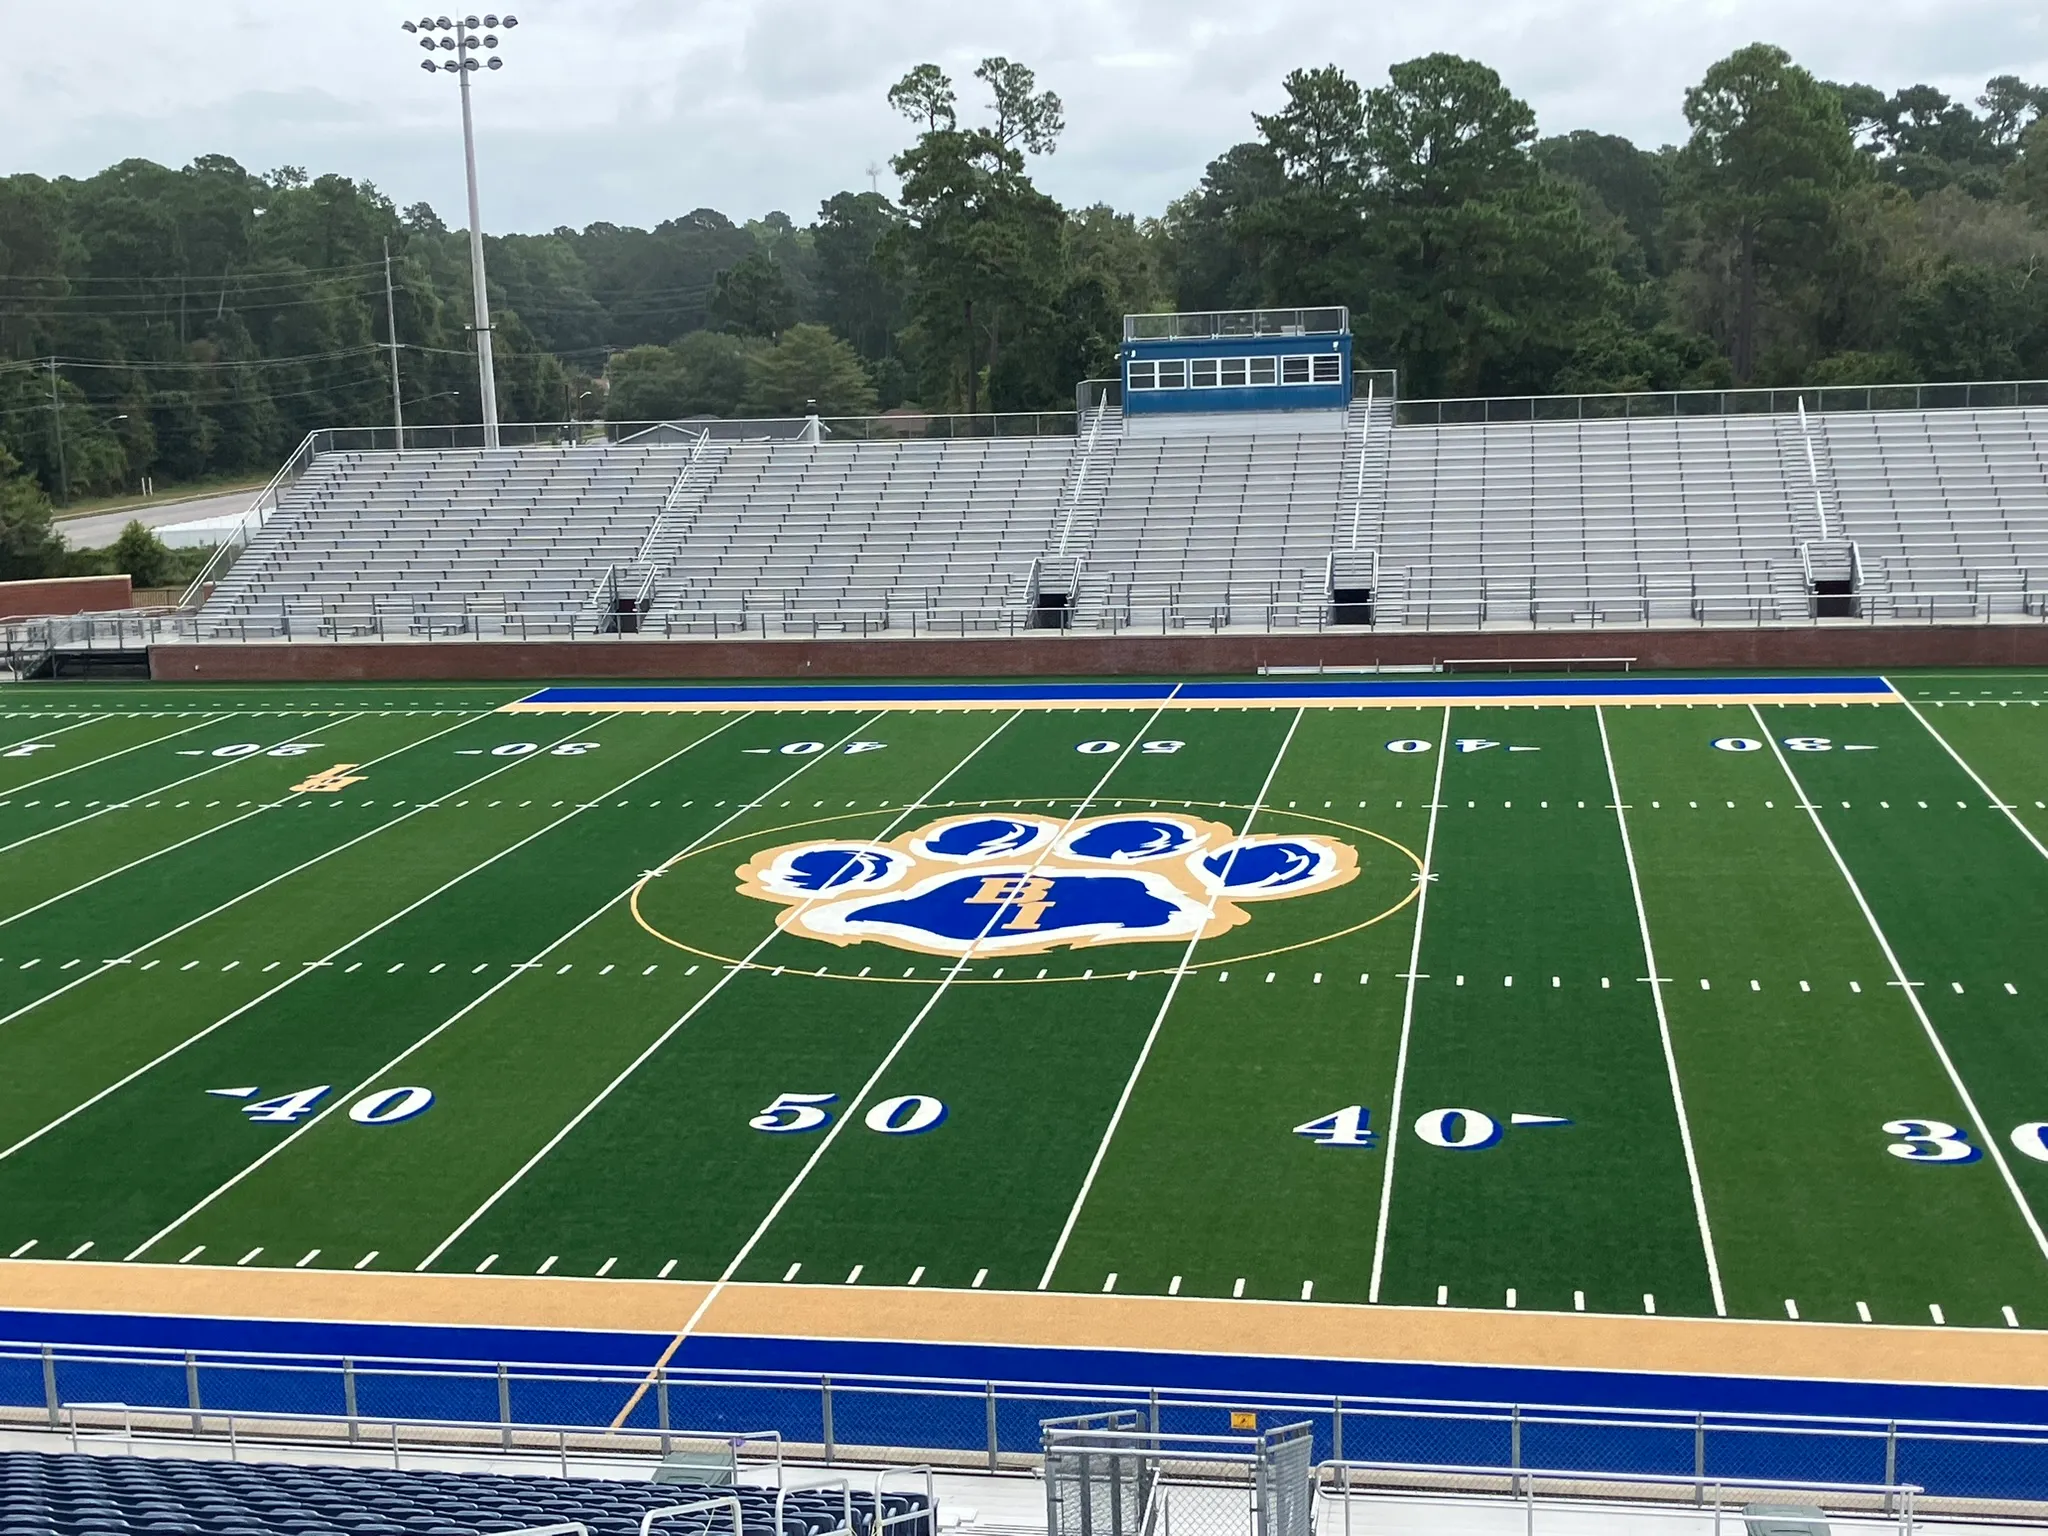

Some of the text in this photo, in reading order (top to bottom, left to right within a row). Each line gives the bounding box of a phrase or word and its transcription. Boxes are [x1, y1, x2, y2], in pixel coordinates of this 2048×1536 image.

[490, 741, 601, 756] 30
[779, 741, 888, 755] 40
[1074, 739, 1187, 754] 50
[1385, 739, 1501, 753] 40
[1710, 737, 1833, 752] 30
[241, 1085, 436, 1125] 40
[749, 1092, 949, 1135] 50
[1292, 1105, 1504, 1150] 40
